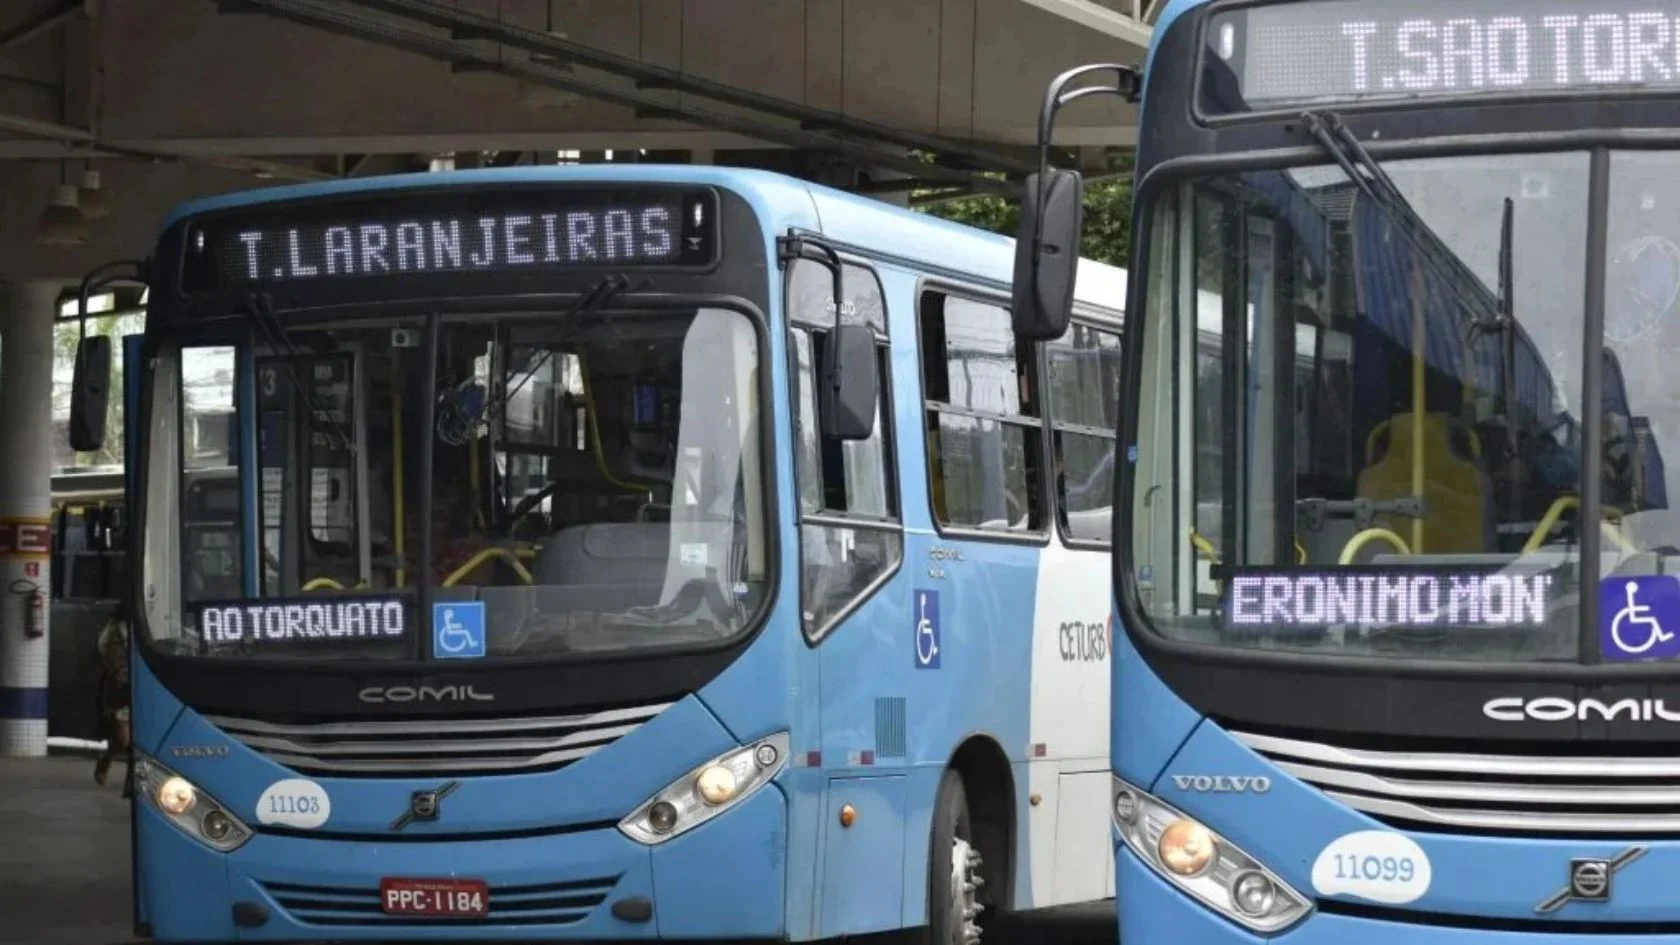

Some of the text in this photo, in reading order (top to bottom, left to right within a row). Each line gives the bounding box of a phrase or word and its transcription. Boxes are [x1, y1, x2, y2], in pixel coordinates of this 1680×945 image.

[1342, 12, 1680, 90] T.SAO TOR
[240, 207, 671, 278] T.LARANJEIRAS
[1233, 576, 1438, 624] ERONIMO
[203, 601, 403, 641] AO TORQUATO
[1060, 621, 1105, 662] CETURB
[358, 685, 495, 703] COMIL
[1172, 775, 1271, 793] VOLVO
[269, 795, 320, 814] 11103
[1333, 854, 1414, 882] 11099
